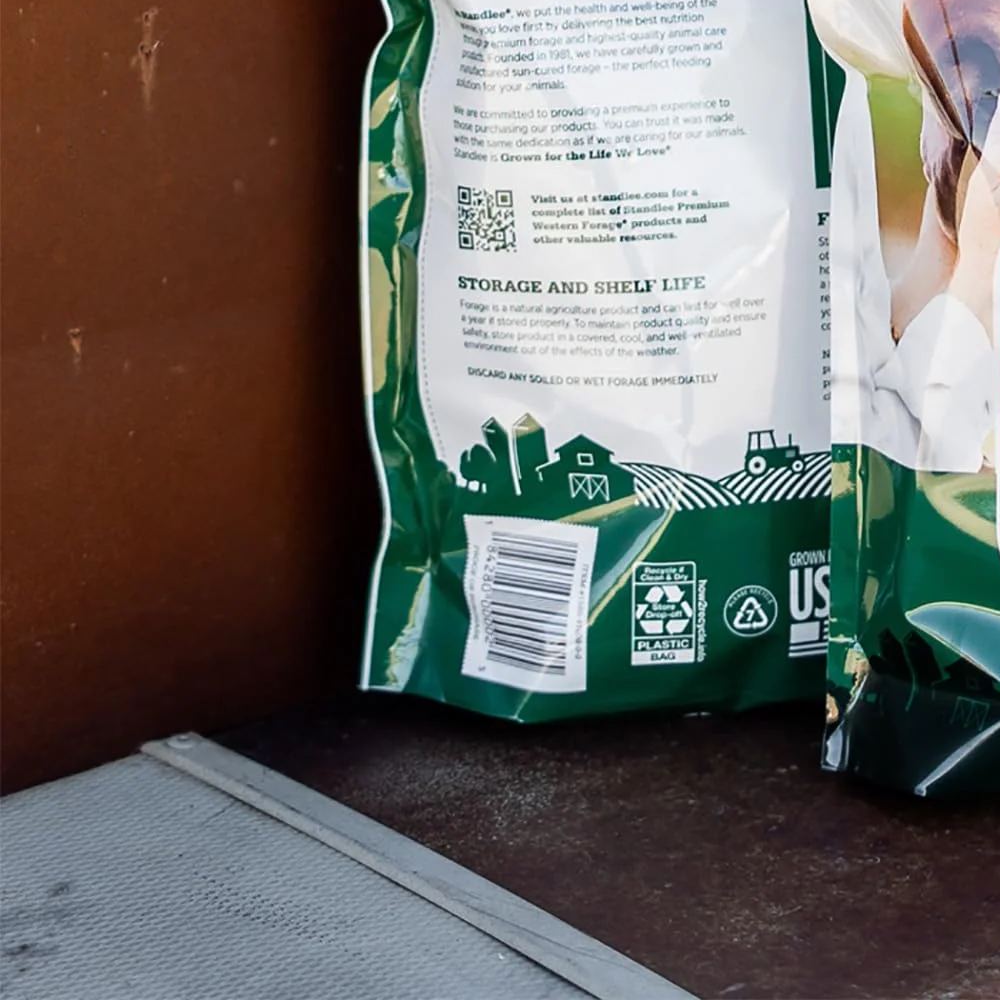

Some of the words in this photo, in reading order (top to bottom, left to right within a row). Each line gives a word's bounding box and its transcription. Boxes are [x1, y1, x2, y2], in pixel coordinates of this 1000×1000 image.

[534, 6, 552, 17] put
[554, 5, 572, 15] the
[574, 2, 607, 14] health
[609, 2, 628, 12] and
[632, 0, 685, 11] well-being
[523, 22, 543, 32] first
[616, 16, 633, 26] the
[635, 15, 657, 26] best
[660, 12, 705, 24] nutrition
[668, 27, 702, 38] animal
[704, 26, 727, 37] care
[703, 41, 723, 51] and
[480, 109, 534, 119] committed
[719, 98, 730, 108] to
[705, 111, 735, 123] made
[573, 137, 584, 146] as
[500, 152, 541, 163] Grown
[545, 151, 562, 162] for
[566, 150, 586, 161] the
[589, 149, 612, 160] Life
[531, 194, 557, 204] Visit
[561, 195, 573, 204] us
[576, 195, 588, 203] at
[591, 190, 669, 203] standlee.com
[671, 188, 688, 199] for
[531, 207, 584, 219] complete
[588, 205, 605, 216] list
[609, 204, 621, 216] of
[623, 203, 674, 215] Standlee
[677, 199, 730, 212] Premium
[532, 220, 578, 231] Western
[631, 216, 682, 230] products
[685, 213, 707, 225] and
[533, 234, 563, 245] other
[567, 233, 617, 244] valuable
[458, 275, 542, 294] STORAGE
[548, 280, 588, 295] AND
[594, 279, 657, 295] SHELF
[662, 275, 706, 292] LIFE
[641, 304, 661, 315] and
[633, 317, 673, 330] product
[646, 331, 665, 343] and
[467, 366, 507, 380] DISCARD
[509, 372, 527, 382] ANY
[530, 374, 564, 386] SOILED
[566, 376, 580, 386] OR
[583, 377, 605, 387] WET
[608, 376, 648, 388] FORAGE
[652, 372, 719, 386] IMMEDIATELY
[789, 552, 826, 568] GROWN
[640, 573, 665, 582] Clean
[674, 572, 689, 582] Dry
[643, 566, 673, 576] Recycle
[651, 602, 676, 611] Store
[644, 610, 683, 619] Drop-off
[637, 639, 690, 650] PLASTIC
[650, 650, 676, 661] BAG
